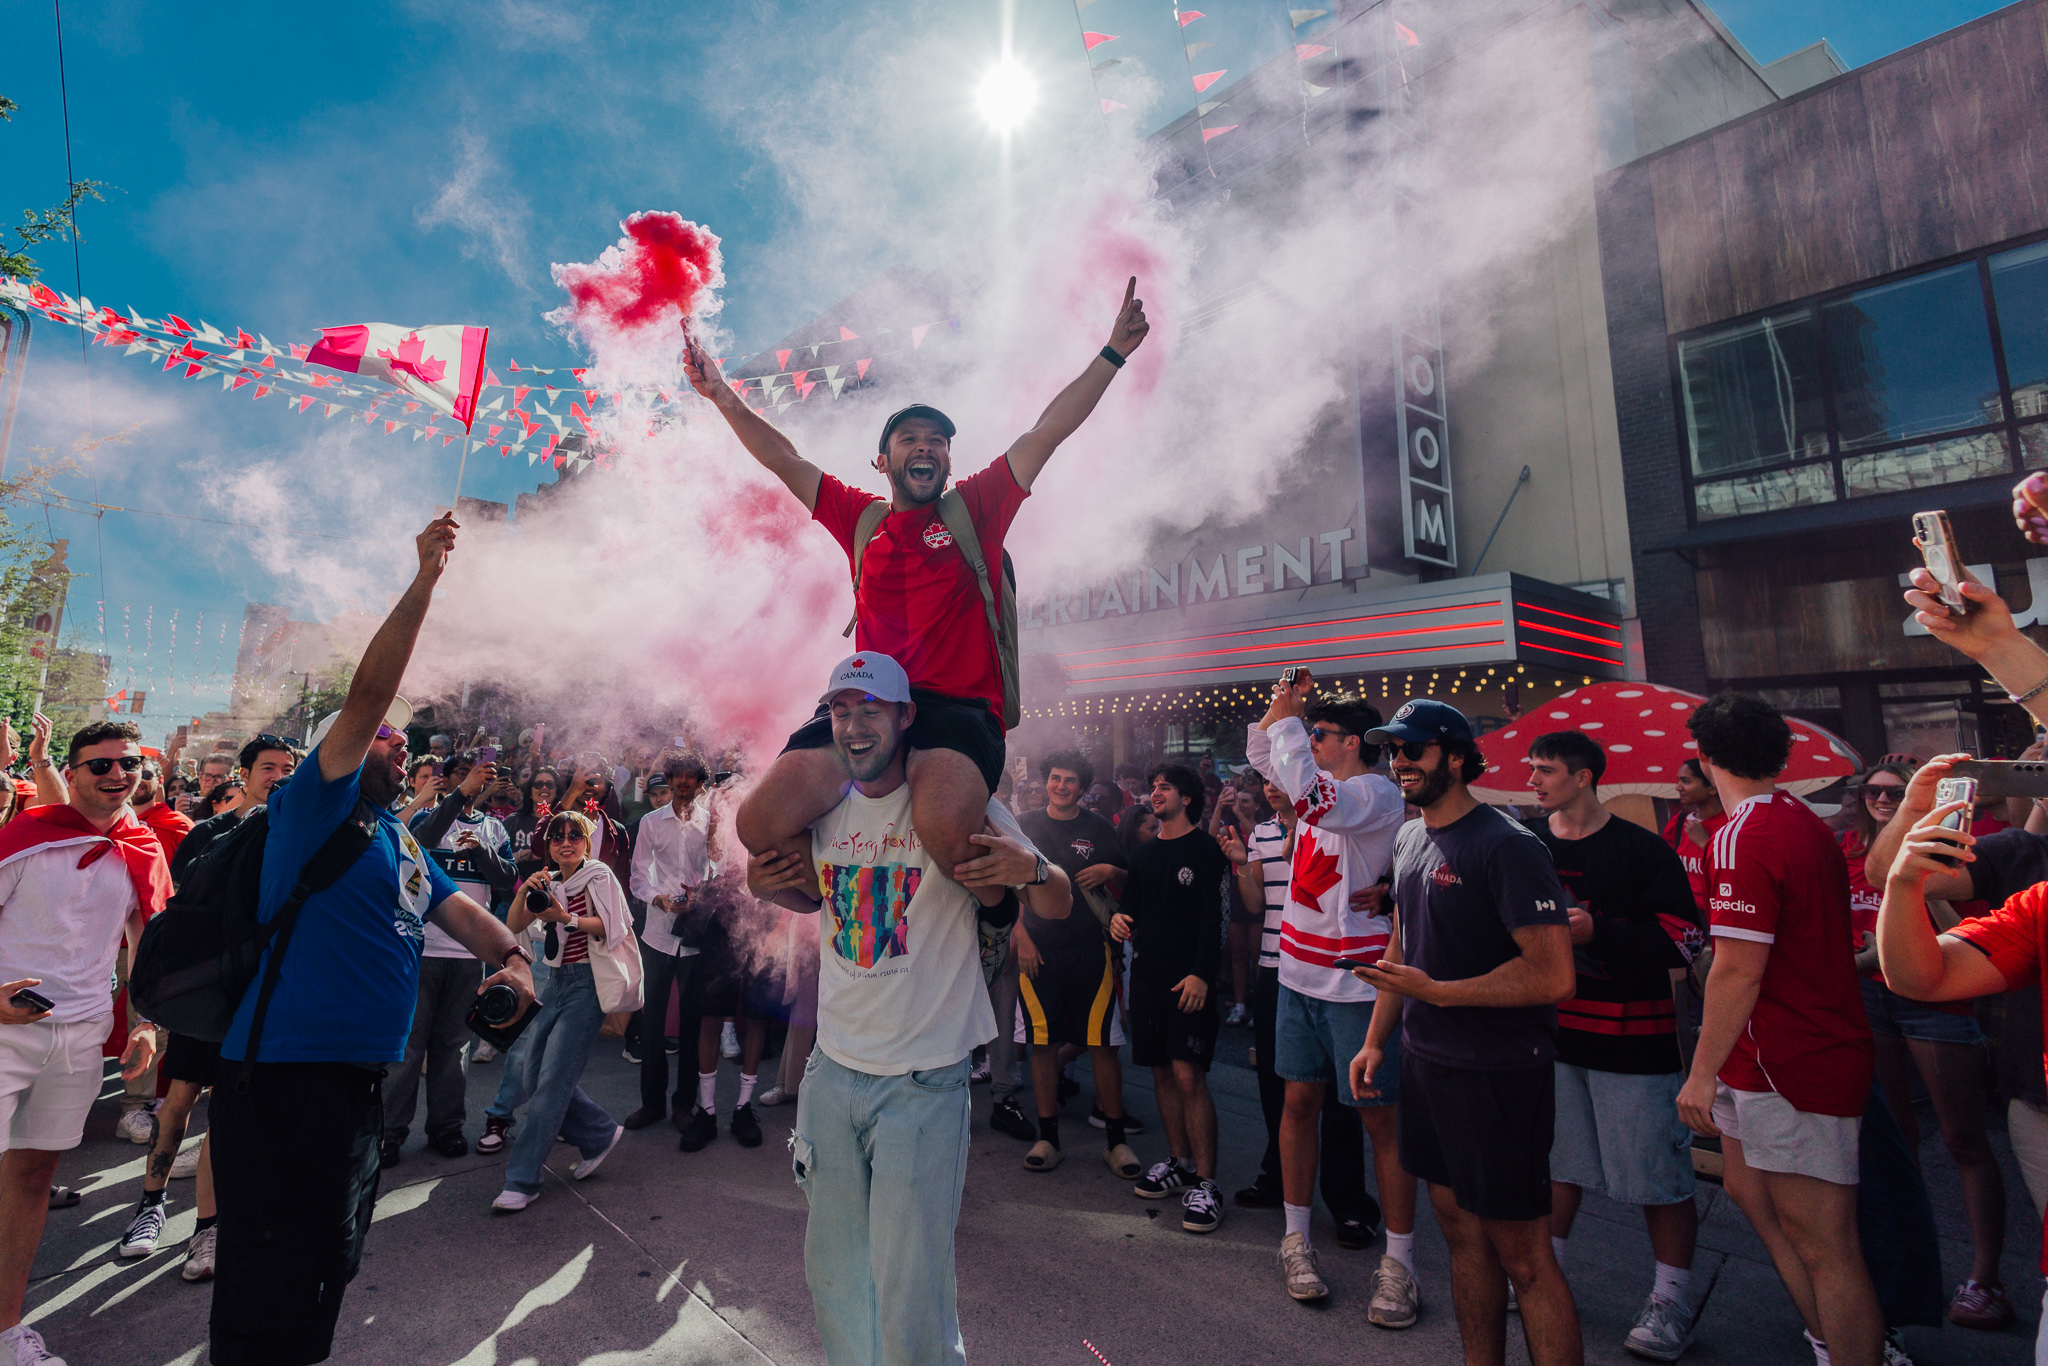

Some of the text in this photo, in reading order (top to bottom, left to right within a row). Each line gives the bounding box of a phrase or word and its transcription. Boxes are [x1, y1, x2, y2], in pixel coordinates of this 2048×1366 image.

[840, 671, 874, 680] CANADA
[1428, 871, 1463, 885] CANADA
[1709, 898, 1756, 914] Epedia
